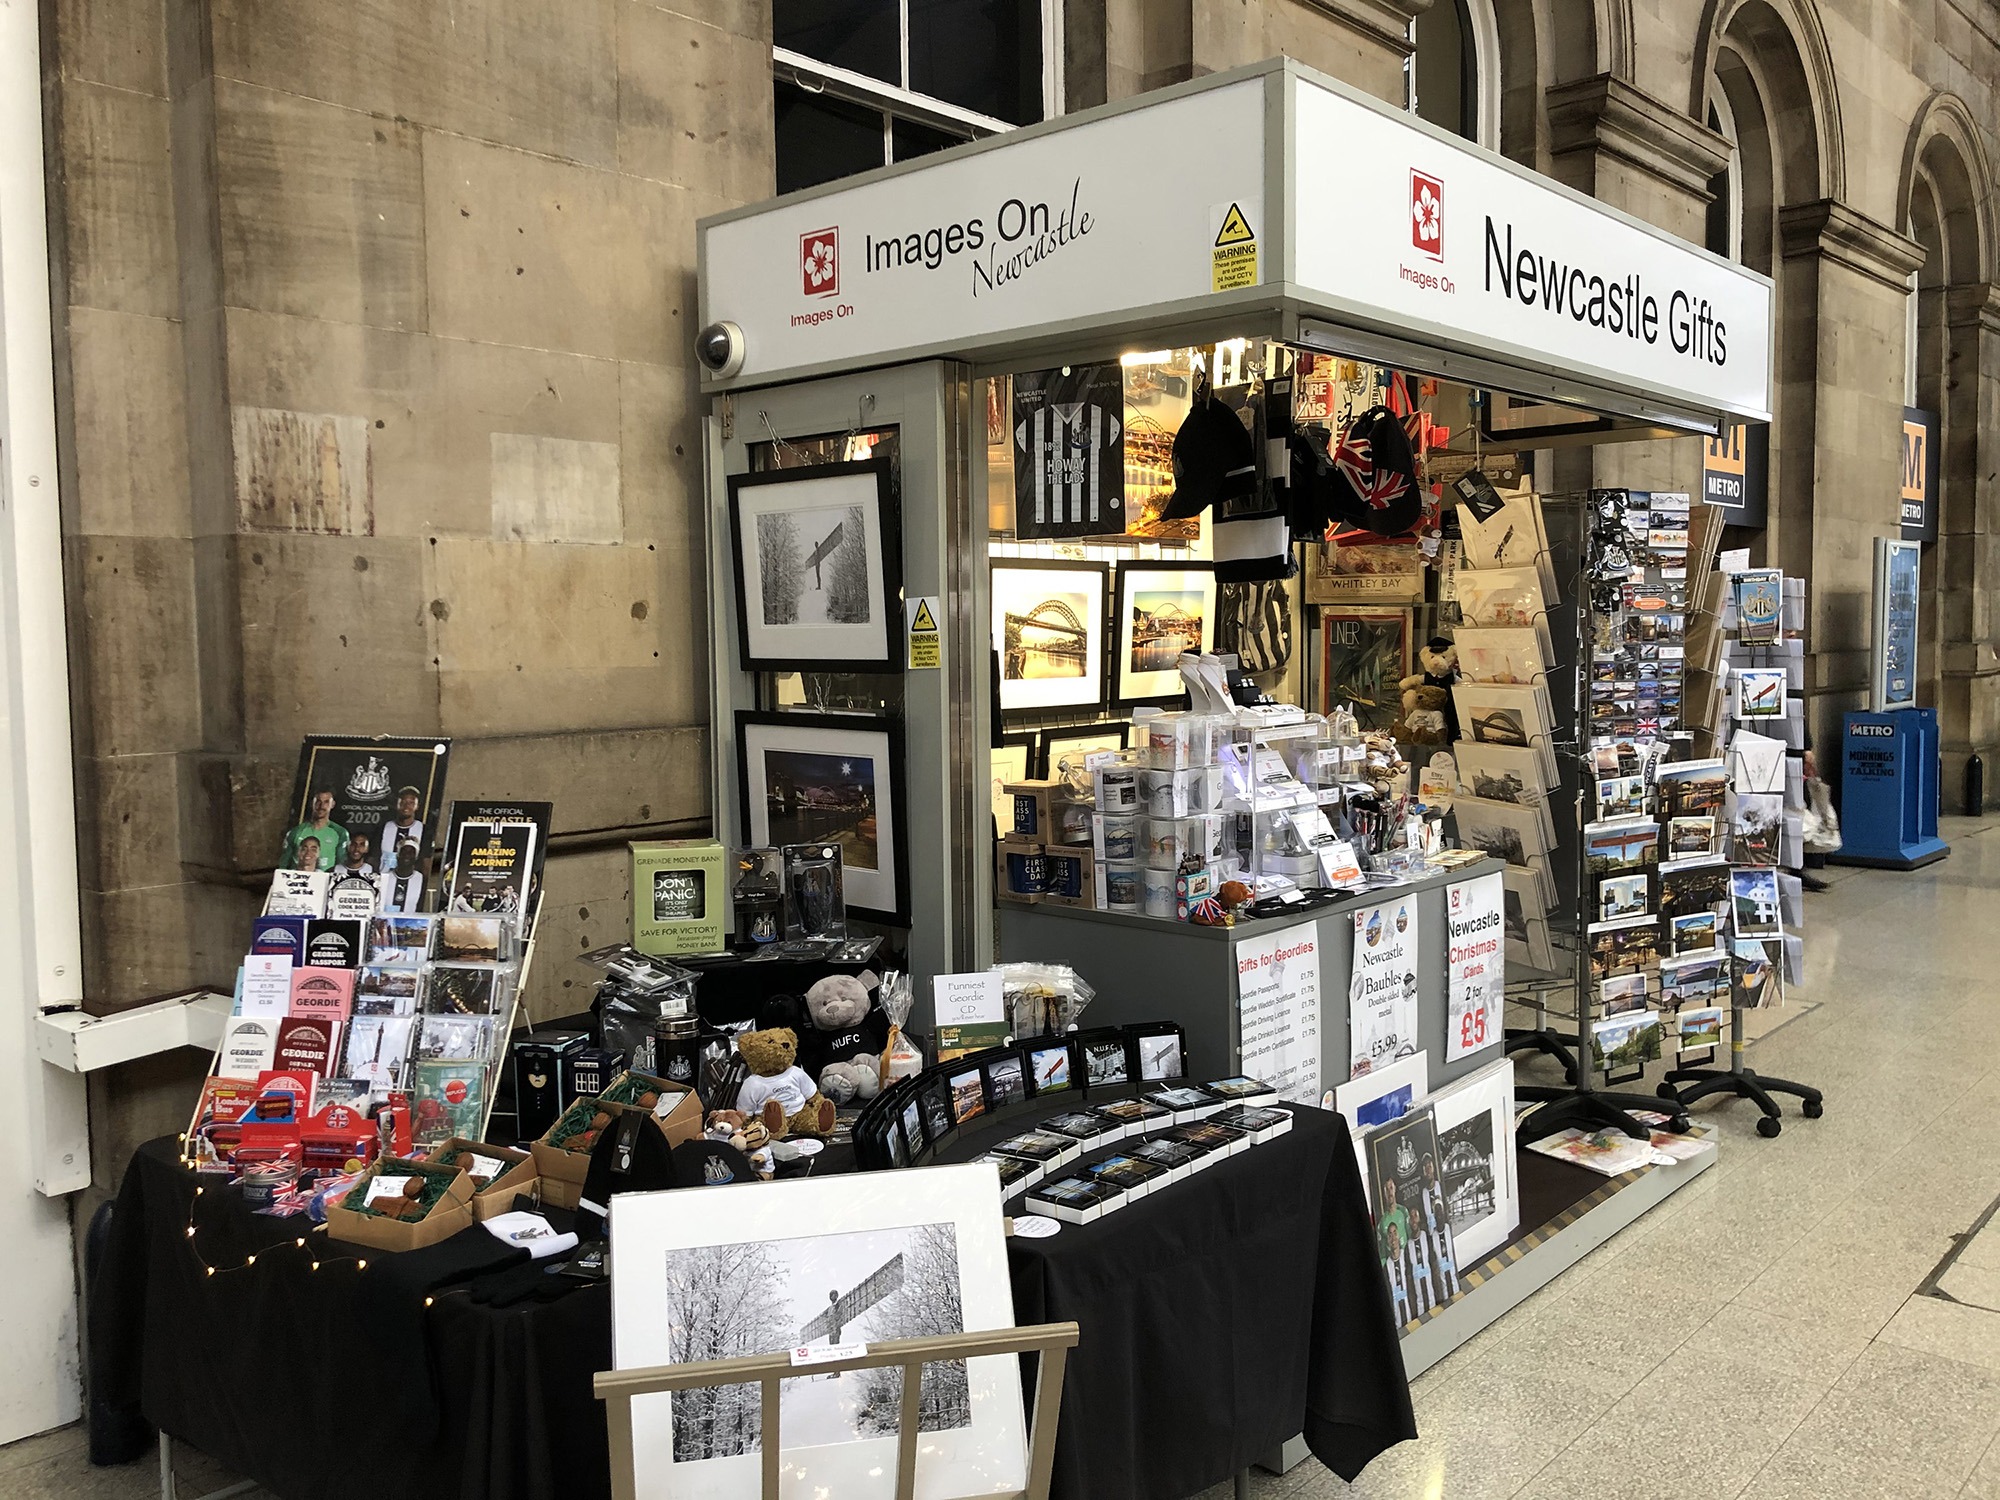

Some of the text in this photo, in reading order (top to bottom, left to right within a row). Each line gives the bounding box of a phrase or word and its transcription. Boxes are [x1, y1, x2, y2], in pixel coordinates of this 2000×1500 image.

[866, 198, 1049, 273] Images On
[972, 176, 1095, 298] Newcastle
[1214, 244, 1256, 260] WARNING
[1230, 257, 1255, 266] premises
[1231, 265, 1247, 273] under
[1236, 271, 1253, 279] CCTV
[1220, 279, 1250, 289] surveillance
[1399, 263, 1455, 294] Images On
[1484, 215, 1727, 366] Newcastle Gifts
[790, 303, 854, 327] Images On
[1016, 389, 1047, 398] NEWCASTLE
[1044, 441, 1061, 452] 1892
[1047, 458, 1086, 472] HOWAY
[1047, 472, 1085, 484] THE LADS
[1708, 476, 1740, 498] METRO
[1332, 578, 1401, 588] WHITLEY BAY
[910, 634, 939, 642] WARNING
[1330, 621, 1360, 645] LNER
[1852, 725, 1893, 736] METRO
[346, 811, 381, 824] 2020
[471, 848, 516, 856] AMAZING
[469, 859, 515, 867] JOURNEY
[655, 877, 694, 889] DON'T
[654, 888, 697, 901] PANIC!
[1449, 910, 1500, 938] Newcastle
[640, 926, 718, 937] SAVE FOR VICTORY!
[1363, 943, 1404, 968] Newcastle
[1450, 938, 1497, 964] Christmas
[1238, 942, 1314, 974] Gifts for Geordies
[1463, 963, 1484, 979] Cards
[948, 981, 985, 990] Funniest
[1258, 983, 1279, 995] Passports
[1301, 970, 1314, 980] £1.75
[1365, 970, 1402, 996] Baubles
[949, 990, 985, 1003] Geordie
[1301, 985, 1315, 995] £1.75
[1465, 985, 1483, 1001] 2 for
[296, 998, 341, 1007] GEORDIE
[1301, 999, 1316, 1009] £1.75
[1368, 988, 1400, 1008] Double sided
[960, 1005, 976, 1014] CD
[1378, 1006, 1393, 1019] metal
[1302, 1013, 1316, 1024] £1.75
[1302, 1028, 1316, 1038] £1.75
[1461, 1008, 1485, 1048] £5
[831, 1033, 861, 1050] NUFC
[1371, 1033, 1398, 1058] £5.99
[281, 1048, 325, 1060] GEORDIE
[1277, 1057, 1316, 1080] Dictionary £3.50
[1302, 1072, 1317, 1082] £3.50
[1302, 1088, 1316, 1098] £3.50
[216, 1096, 250, 1106] London
[215, 1105, 233, 1114] Bus
[1402, 1184, 1419, 1200] 2020
